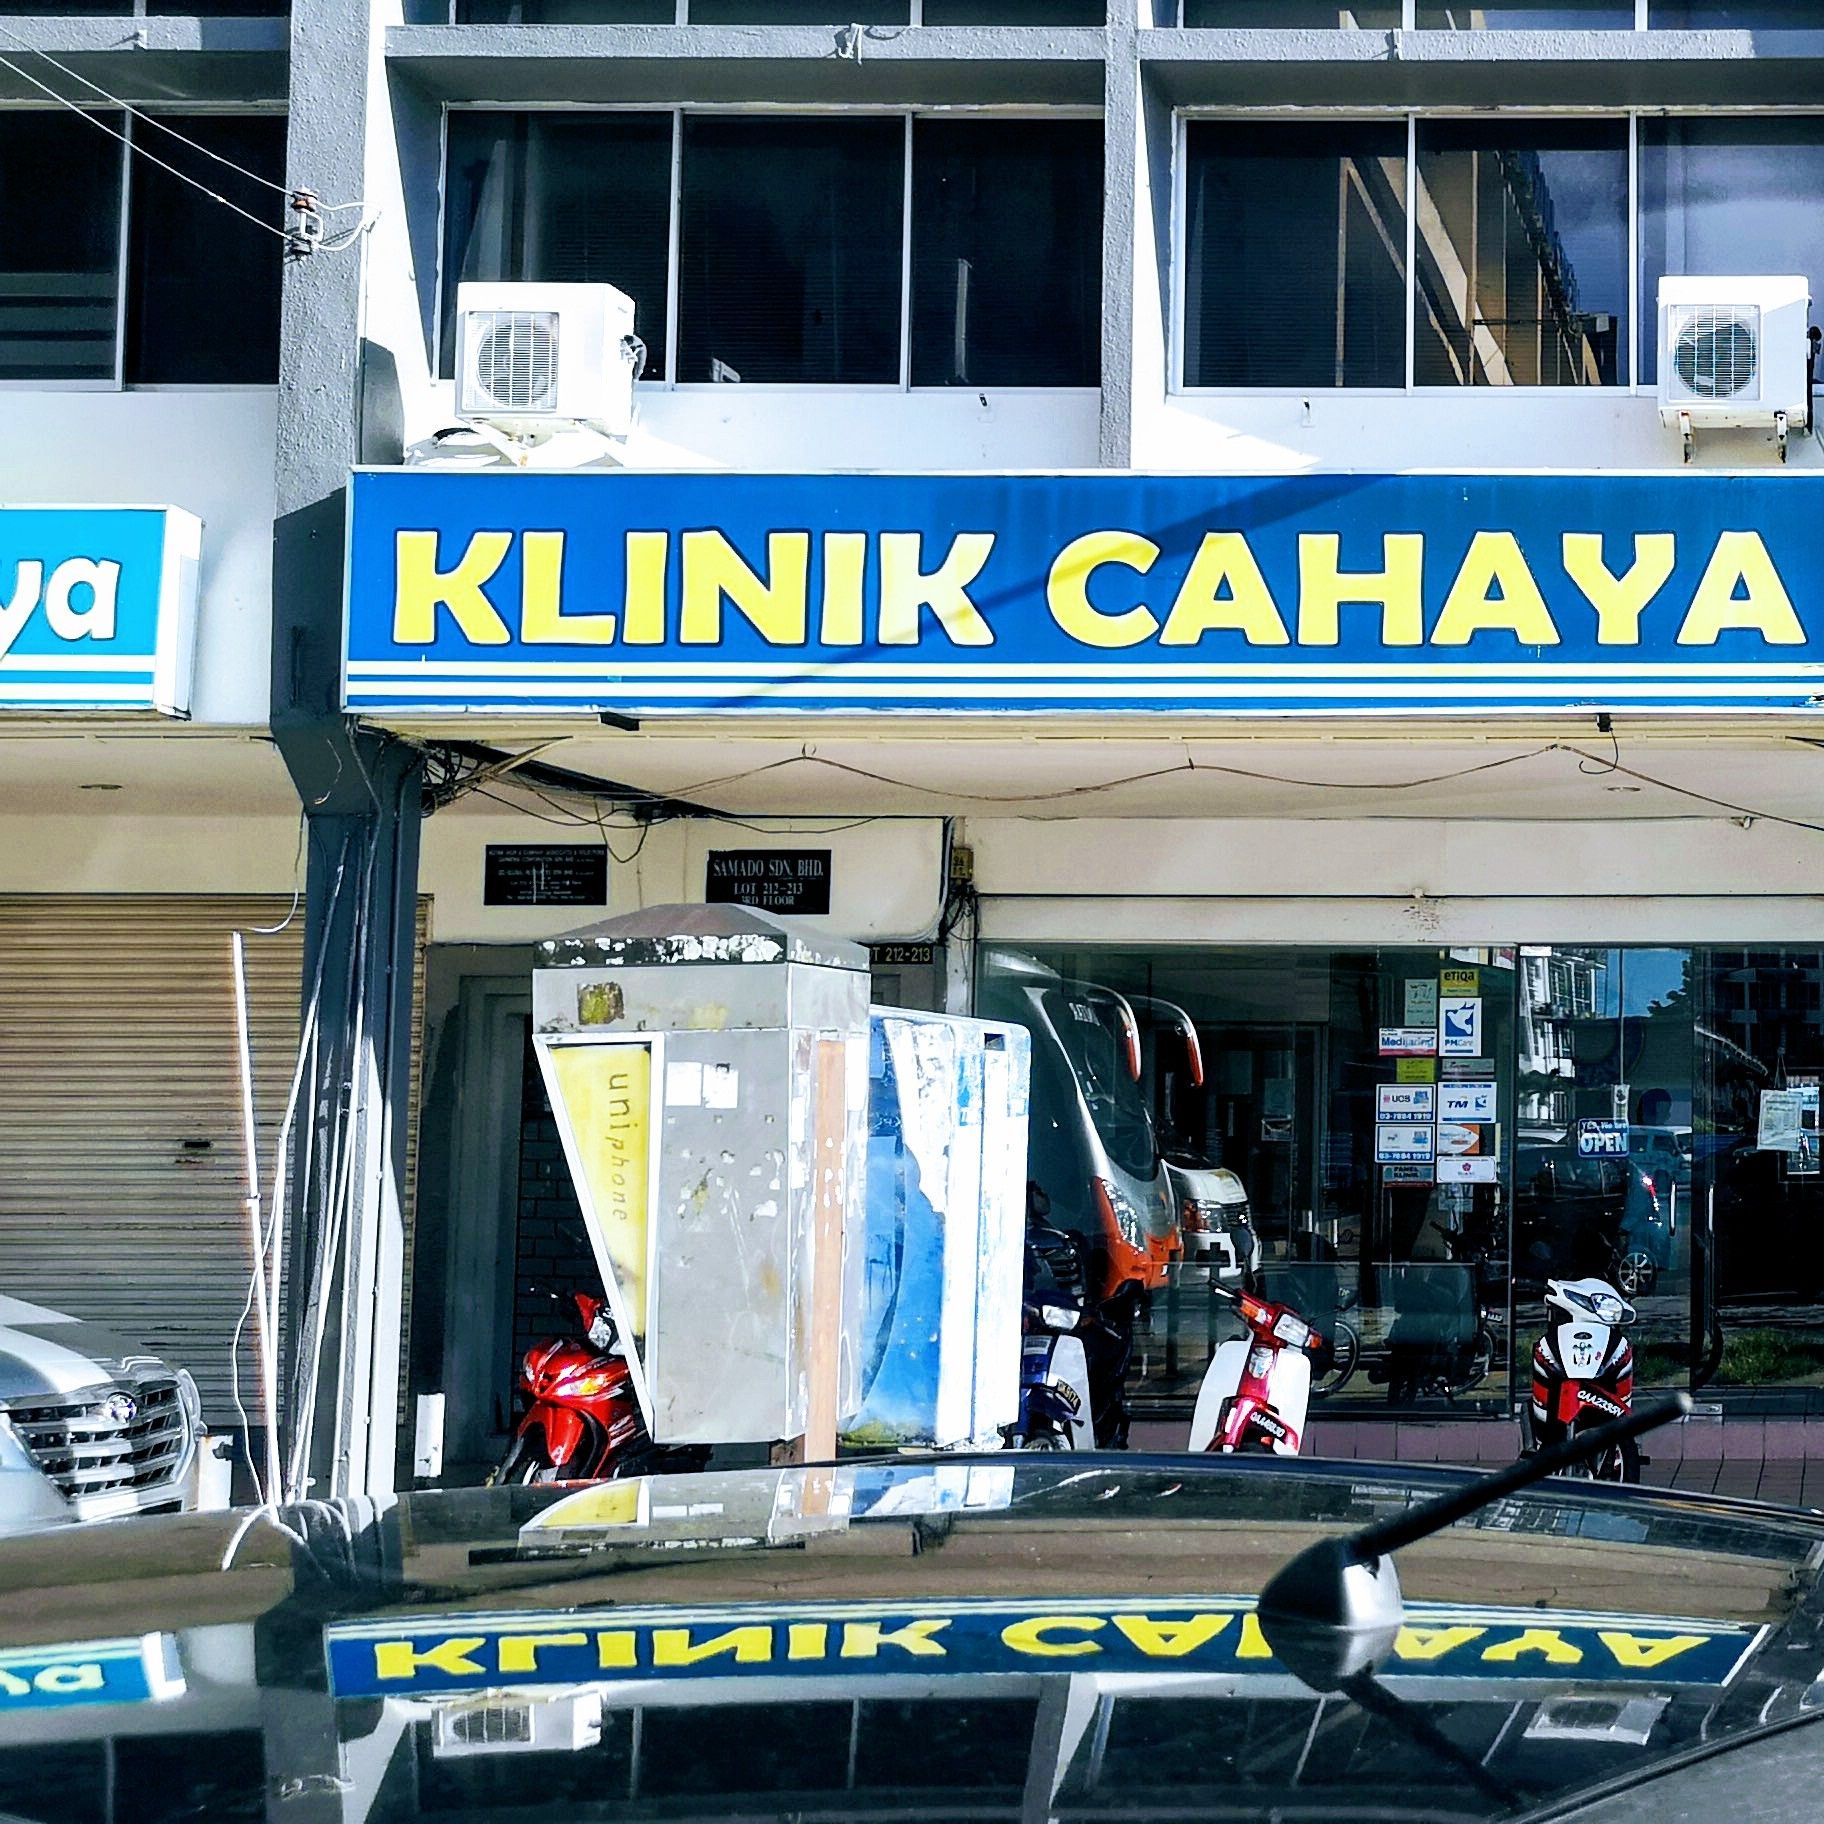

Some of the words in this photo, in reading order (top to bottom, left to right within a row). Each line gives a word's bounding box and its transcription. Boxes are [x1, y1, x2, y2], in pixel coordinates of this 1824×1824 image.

[394, 532, 989, 645] KLINIK
[1048, 531, 1806, 647] CAHAYA
[713, 859, 764, 876] SAMADO
[797, 859, 824, 876] BHD.
[733, 882, 757, 895] LOT
[763, 882, 803, 895] 212-213
[762, 895, 795, 905] FLOOR
[885, 947, 931, 962] 212-213
[1447, 1100, 1469, 1109] TM
[605, 1073, 639, 1221] uniphone
[1580, 1132, 1628, 1153] OPEN
